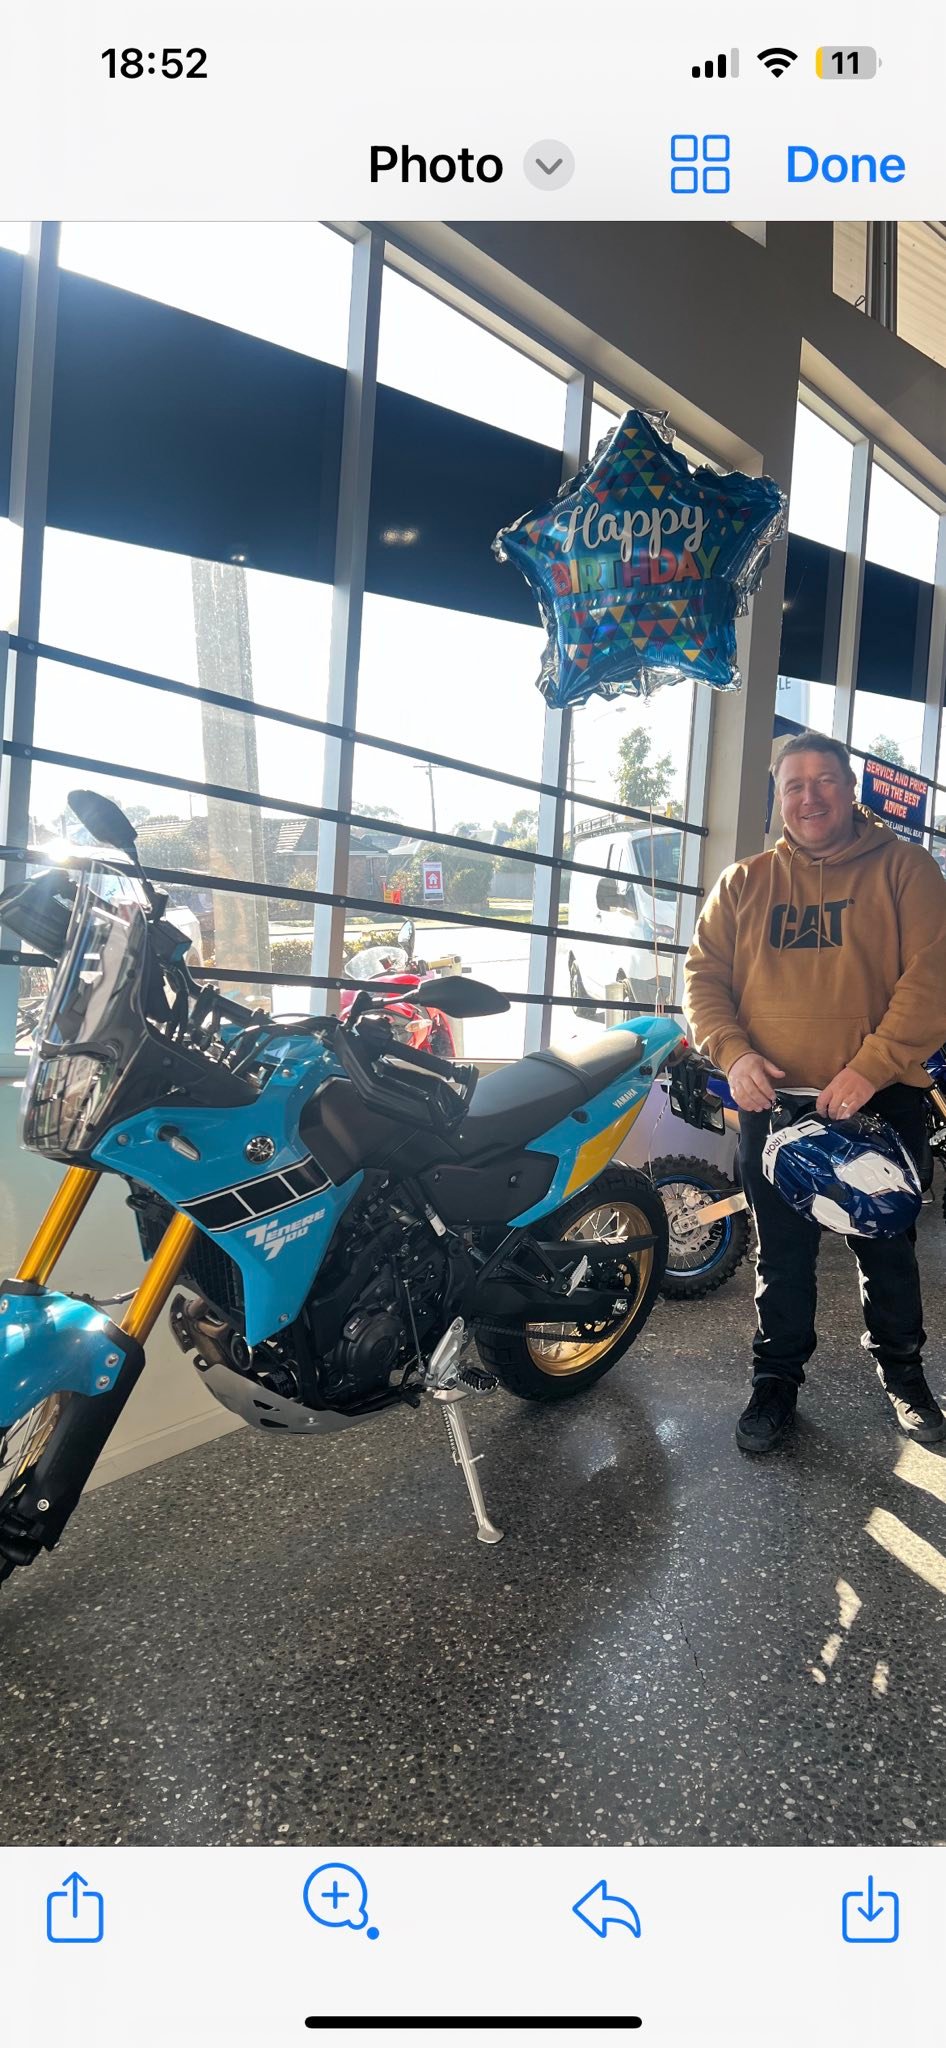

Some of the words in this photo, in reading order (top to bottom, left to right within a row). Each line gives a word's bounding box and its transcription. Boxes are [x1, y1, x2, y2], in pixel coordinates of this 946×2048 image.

[554, 502, 710, 562] Happy
[551, 546, 720, 596] BIRTHDAY
[866, 759, 894, 782] SERVICE
[894, 771, 909, 787] AND
[908, 776, 928, 795] PRICE
[873, 777, 891, 796] WITH
[890, 785, 904, 801] THE
[903, 790, 921, 808] BEST
[883, 798, 908, 818] ADVICE
[769, 898, 848, 948] CAT
[612, 1088, 638, 1109] YAMAHA
[765, 1130, 788, 1157] AIROH
[263, 1225, 309, 1261] 700
